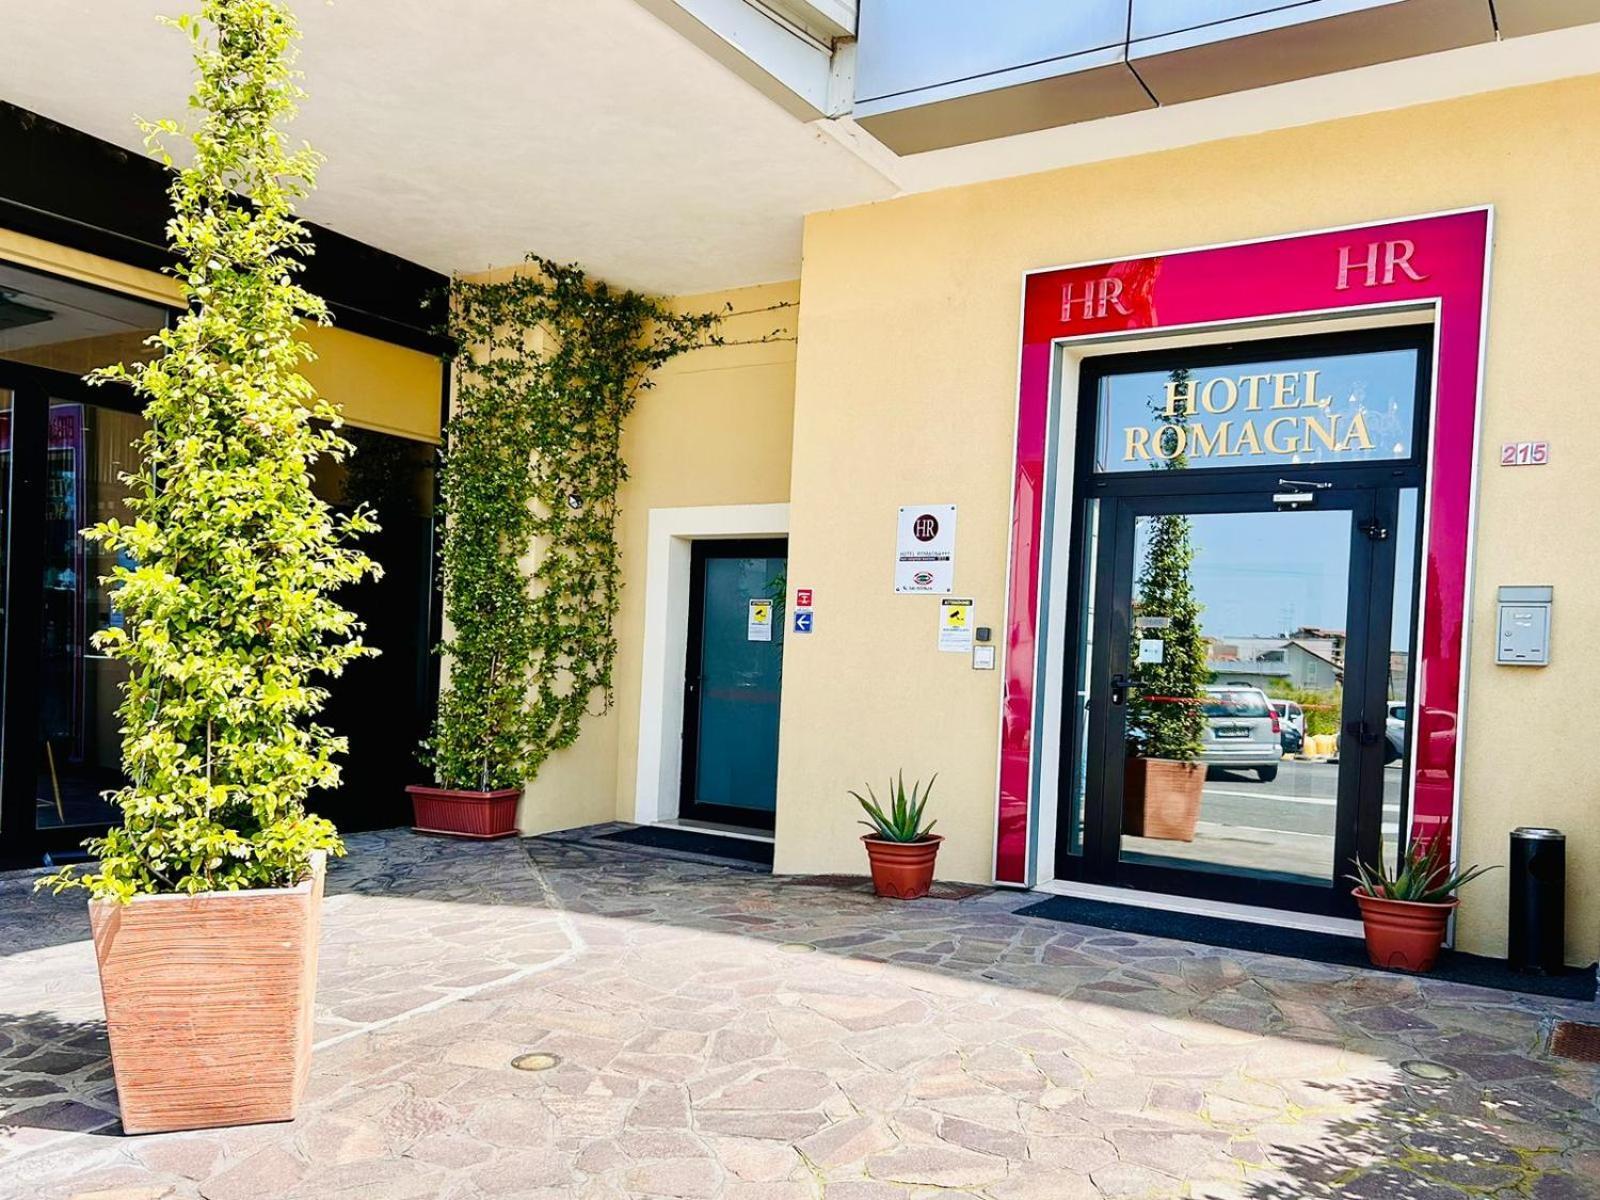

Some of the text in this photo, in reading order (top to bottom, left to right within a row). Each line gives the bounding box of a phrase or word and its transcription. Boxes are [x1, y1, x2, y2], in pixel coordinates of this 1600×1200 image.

[1335, 238, 1429, 291] HR
[1060, 276, 1134, 323] HR
[1163, 369, 1332, 417] HOTEL
[1123, 411, 1375, 462] ROMAGNA
[1502, 443, 1546, 465] 215
[915, 519, 935, 538] HR
